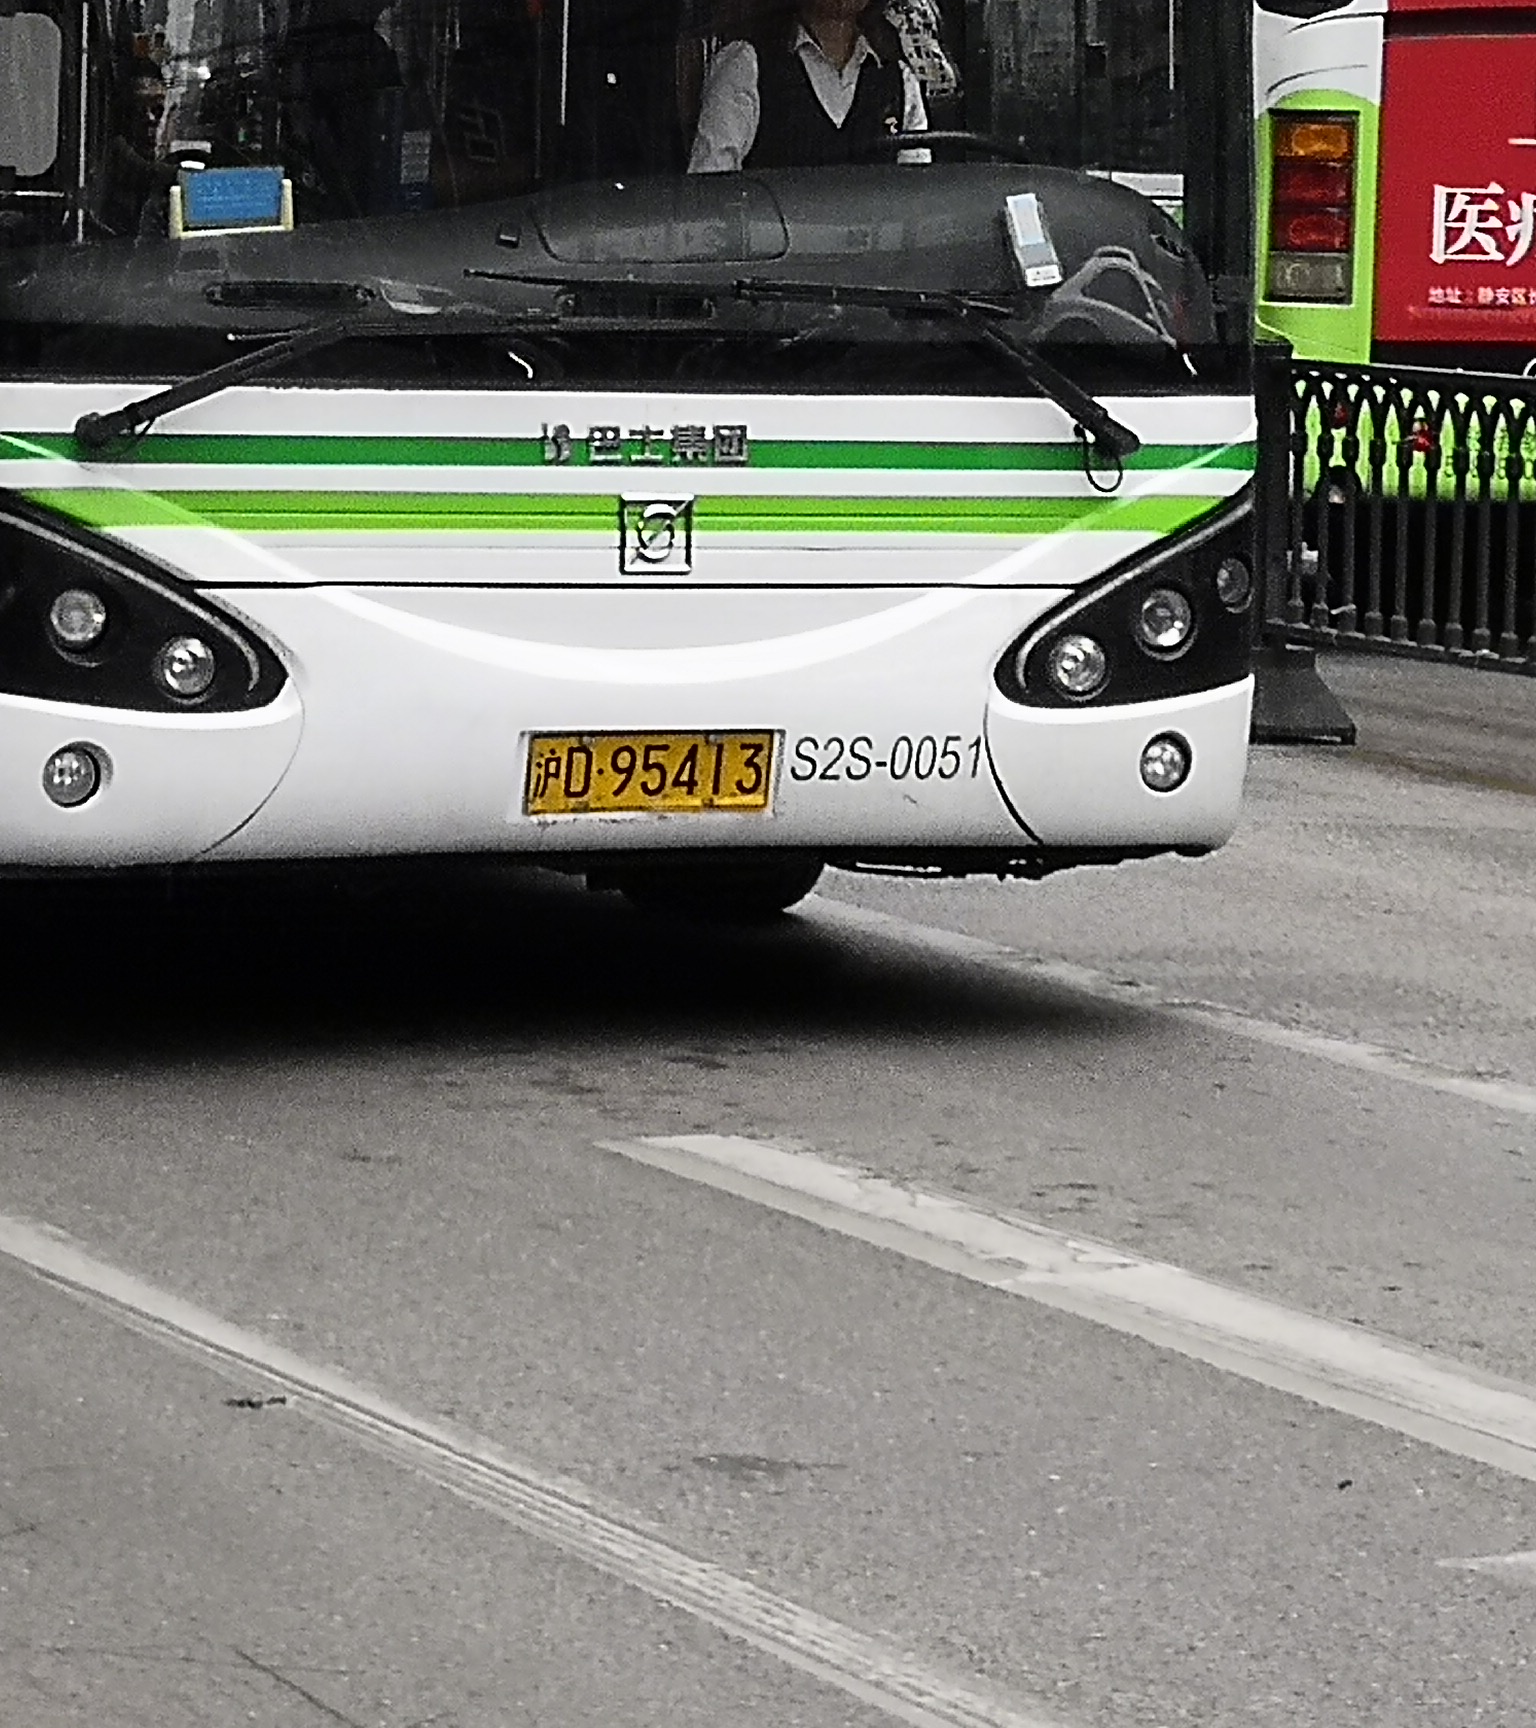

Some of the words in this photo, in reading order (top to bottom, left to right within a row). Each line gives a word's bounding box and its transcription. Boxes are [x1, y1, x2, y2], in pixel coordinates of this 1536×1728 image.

[588, 423, 748, 468] 巴士集团
[791, 735, 983, 782] S2S-0051
